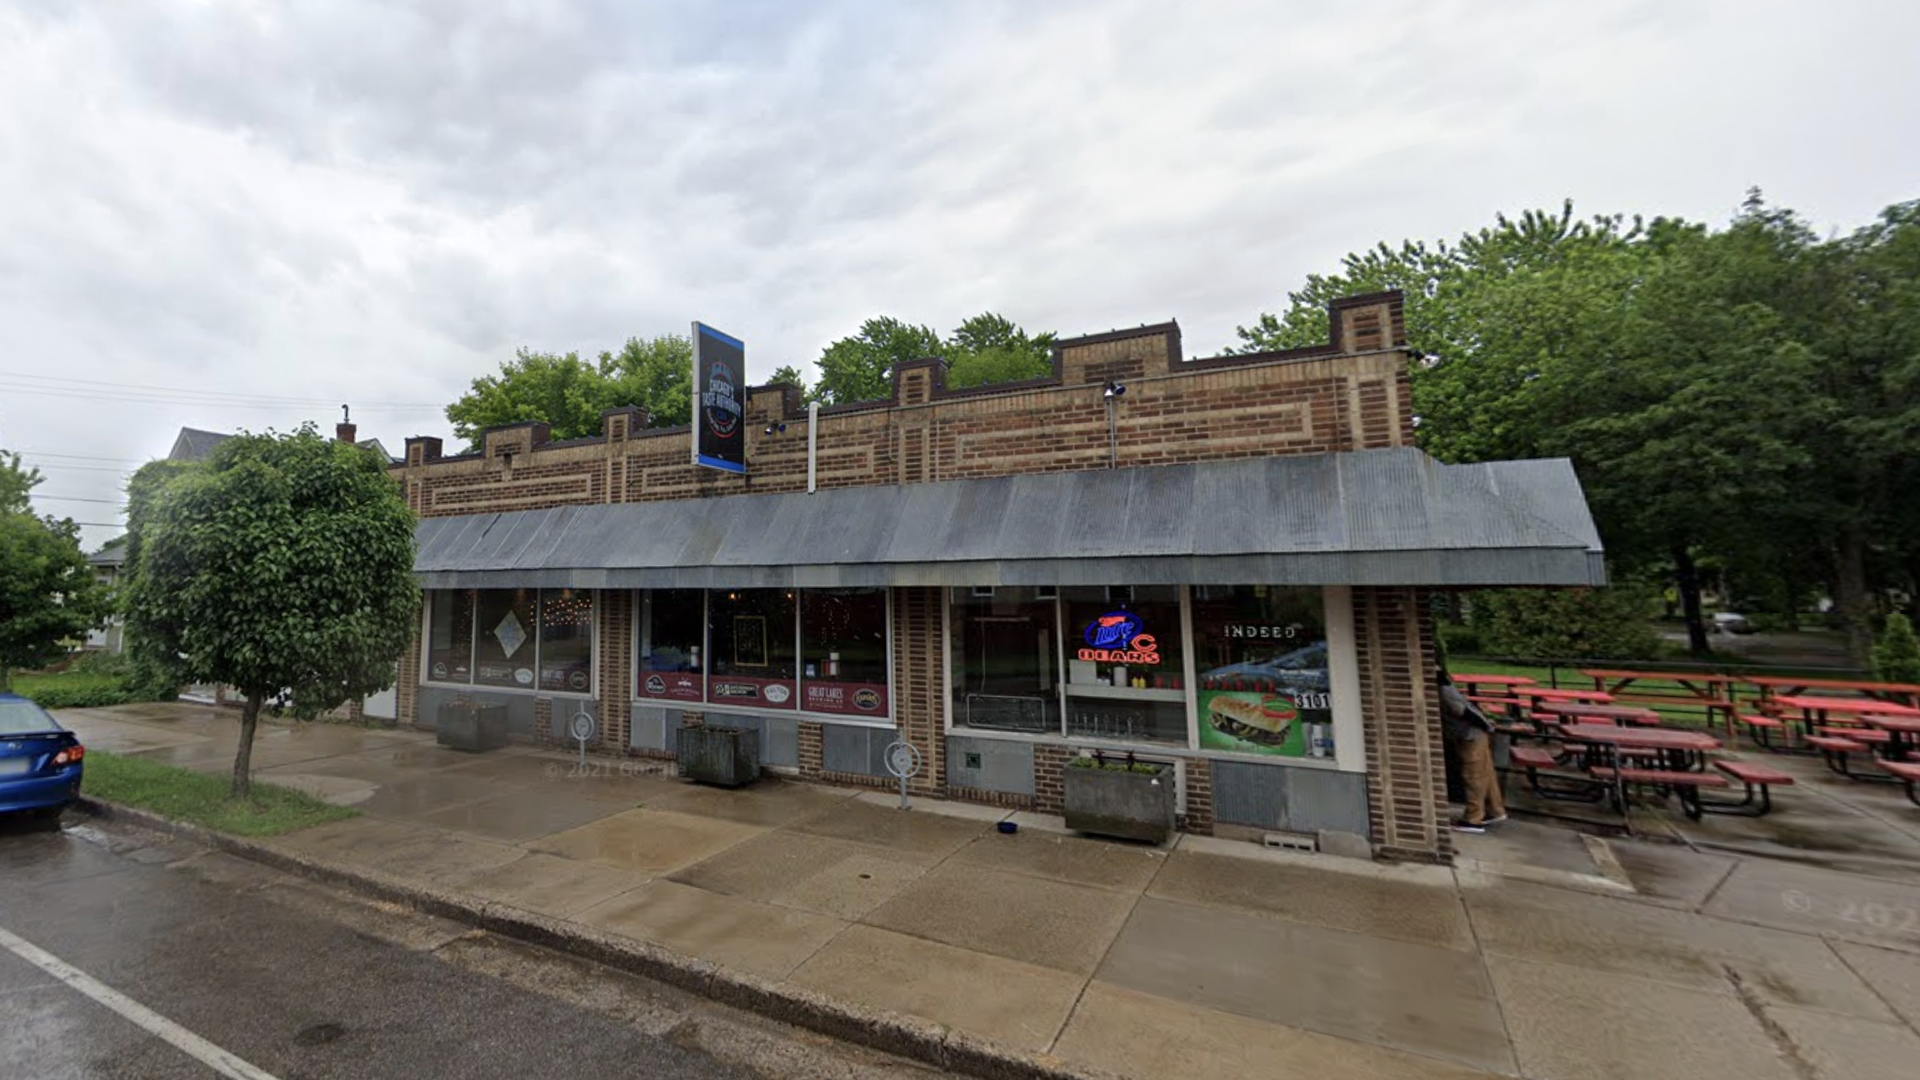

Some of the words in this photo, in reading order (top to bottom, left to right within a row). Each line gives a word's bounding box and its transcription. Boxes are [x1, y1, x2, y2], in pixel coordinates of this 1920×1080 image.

[709, 379, 734, 399] CHICAGO'S
[1223, 625, 1296, 639] INDEED
[1078, 648, 1160, 665] BEARS
[808, 686, 825, 698] GREAT
[826, 687, 844, 699] LAKES
[1296, 693, 1329, 708] 3101
